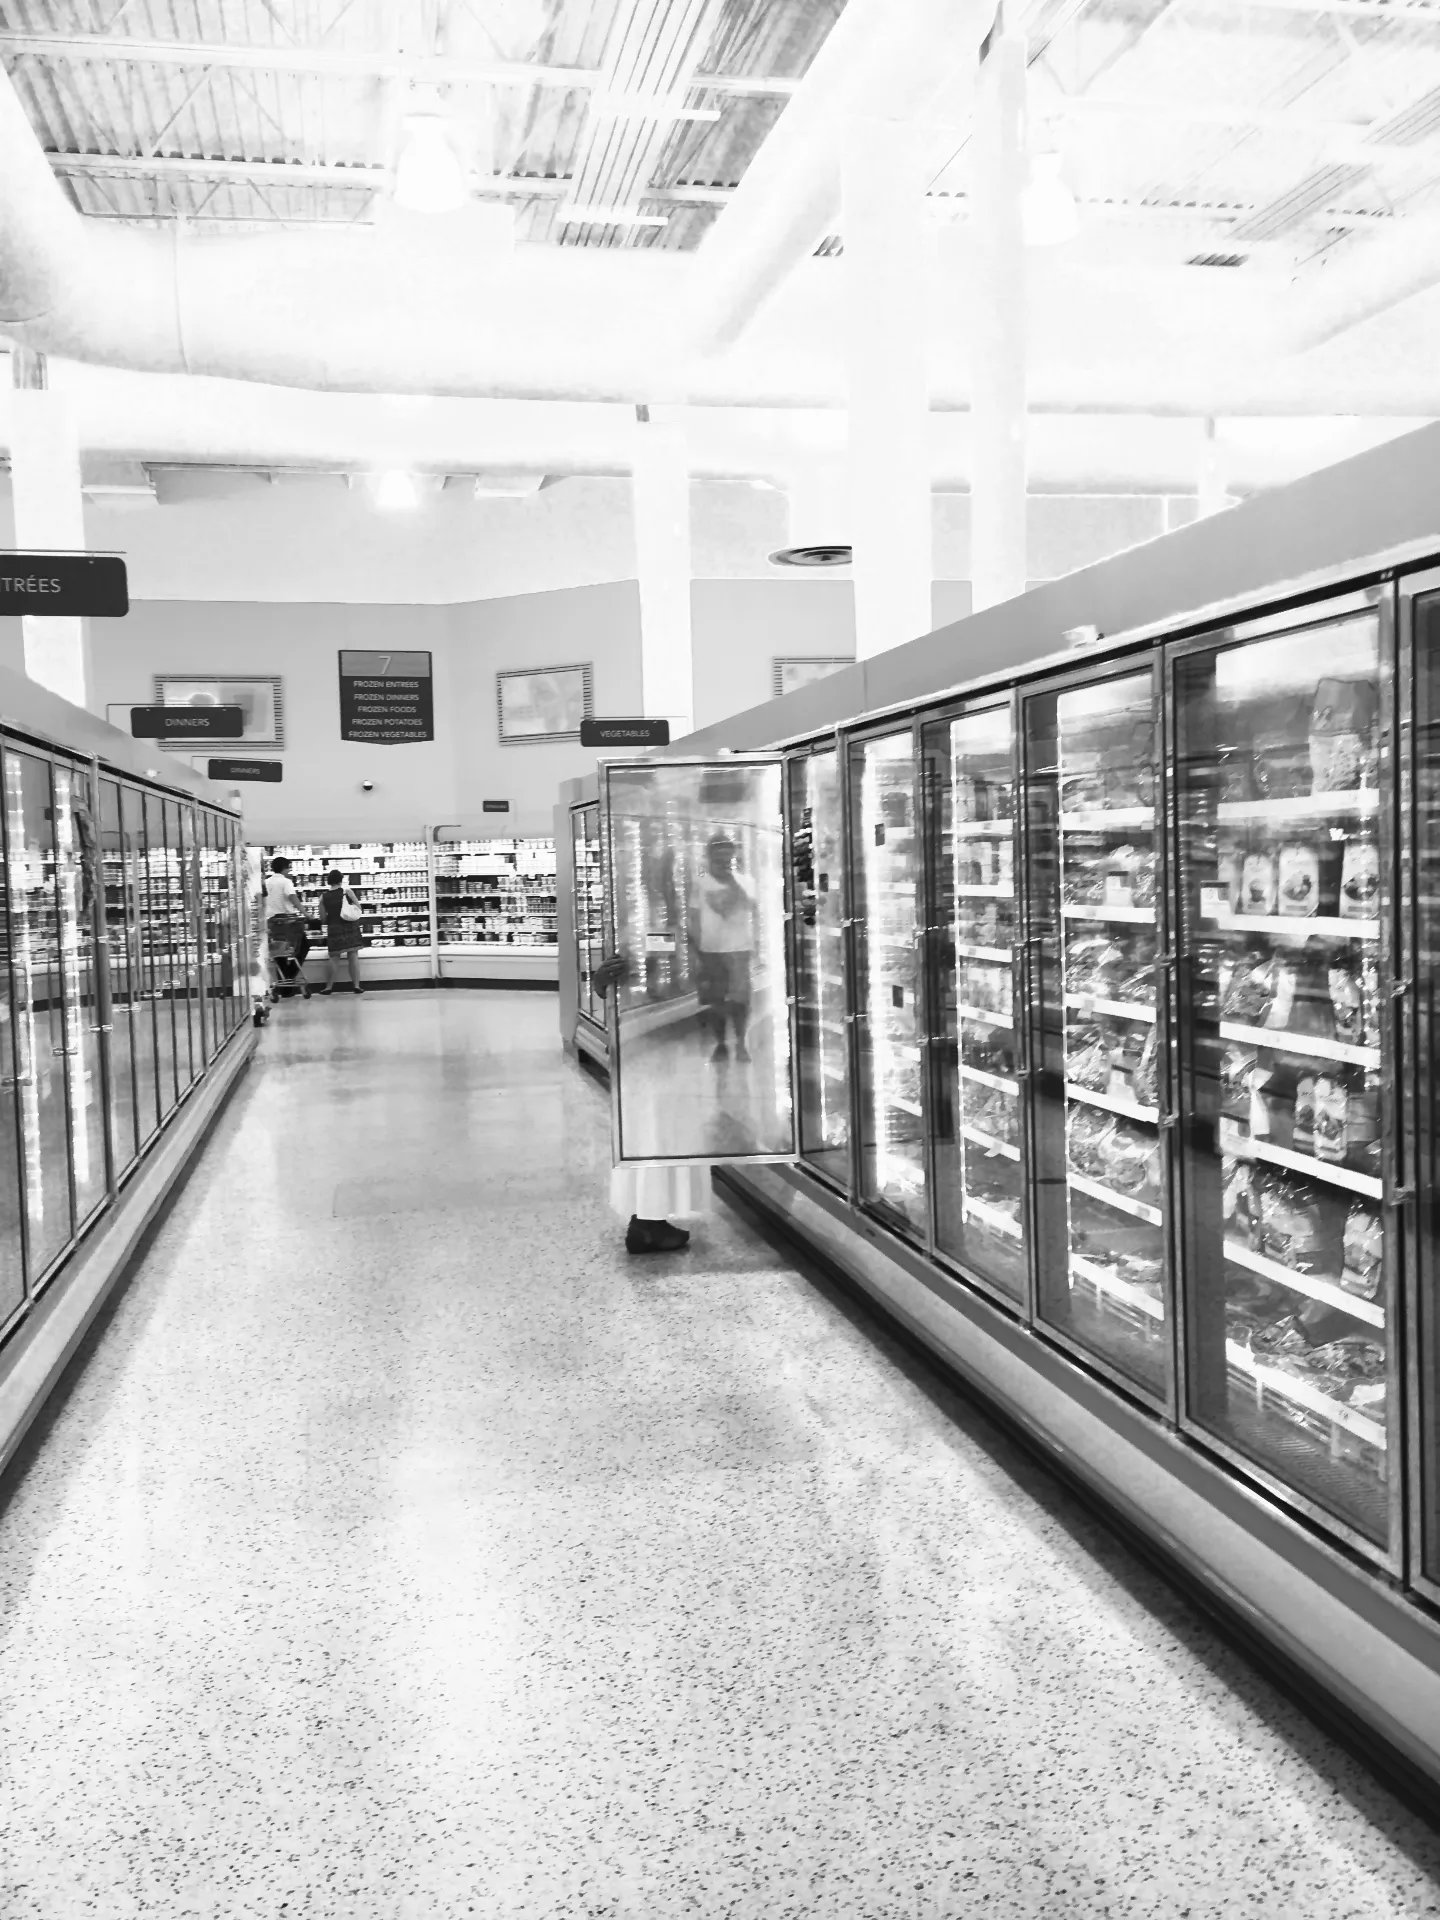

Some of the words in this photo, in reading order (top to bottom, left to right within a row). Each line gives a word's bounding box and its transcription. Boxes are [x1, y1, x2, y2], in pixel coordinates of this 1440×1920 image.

[0, 574, 61, 593] TRÉES
[377, 655, 392, 675] 7
[353, 680, 384, 688] FROZEN
[353, 693, 384, 701] FROZEN
[386, 693, 419, 701] DINNERS
[357, 705, 388, 713] FROZEN
[389, 705, 417, 713] FOODS
[165, 718, 210, 727] DINNERS
[352, 718, 383, 726] FROZEN
[384, 718, 423, 726] POTATOES
[348, 730, 379, 738] FROZEN
[380, 730, 427, 738] VEGETABLES
[599, 729, 651, 738] VEGETABLES
[230, 767, 261, 775] DINNERS
